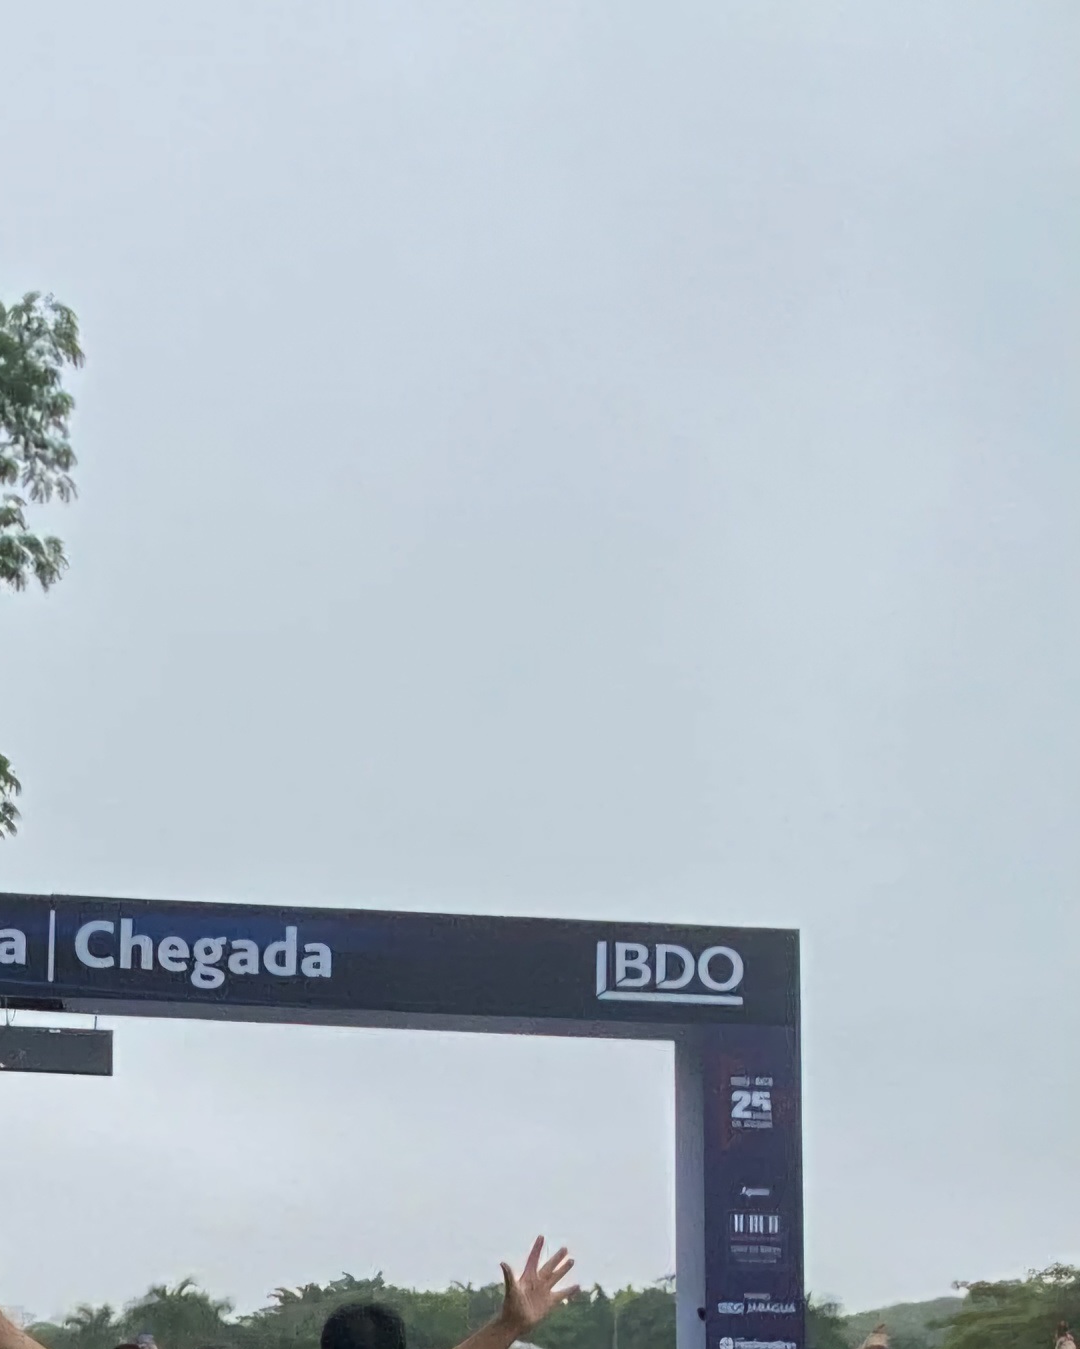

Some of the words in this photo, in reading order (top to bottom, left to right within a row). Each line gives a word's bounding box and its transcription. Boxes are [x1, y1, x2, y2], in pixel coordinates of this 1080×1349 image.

[74, 917, 332, 989] Chegada
[615, 941, 744, 992] BDO
[731, 1090, 772, 1119] 25
